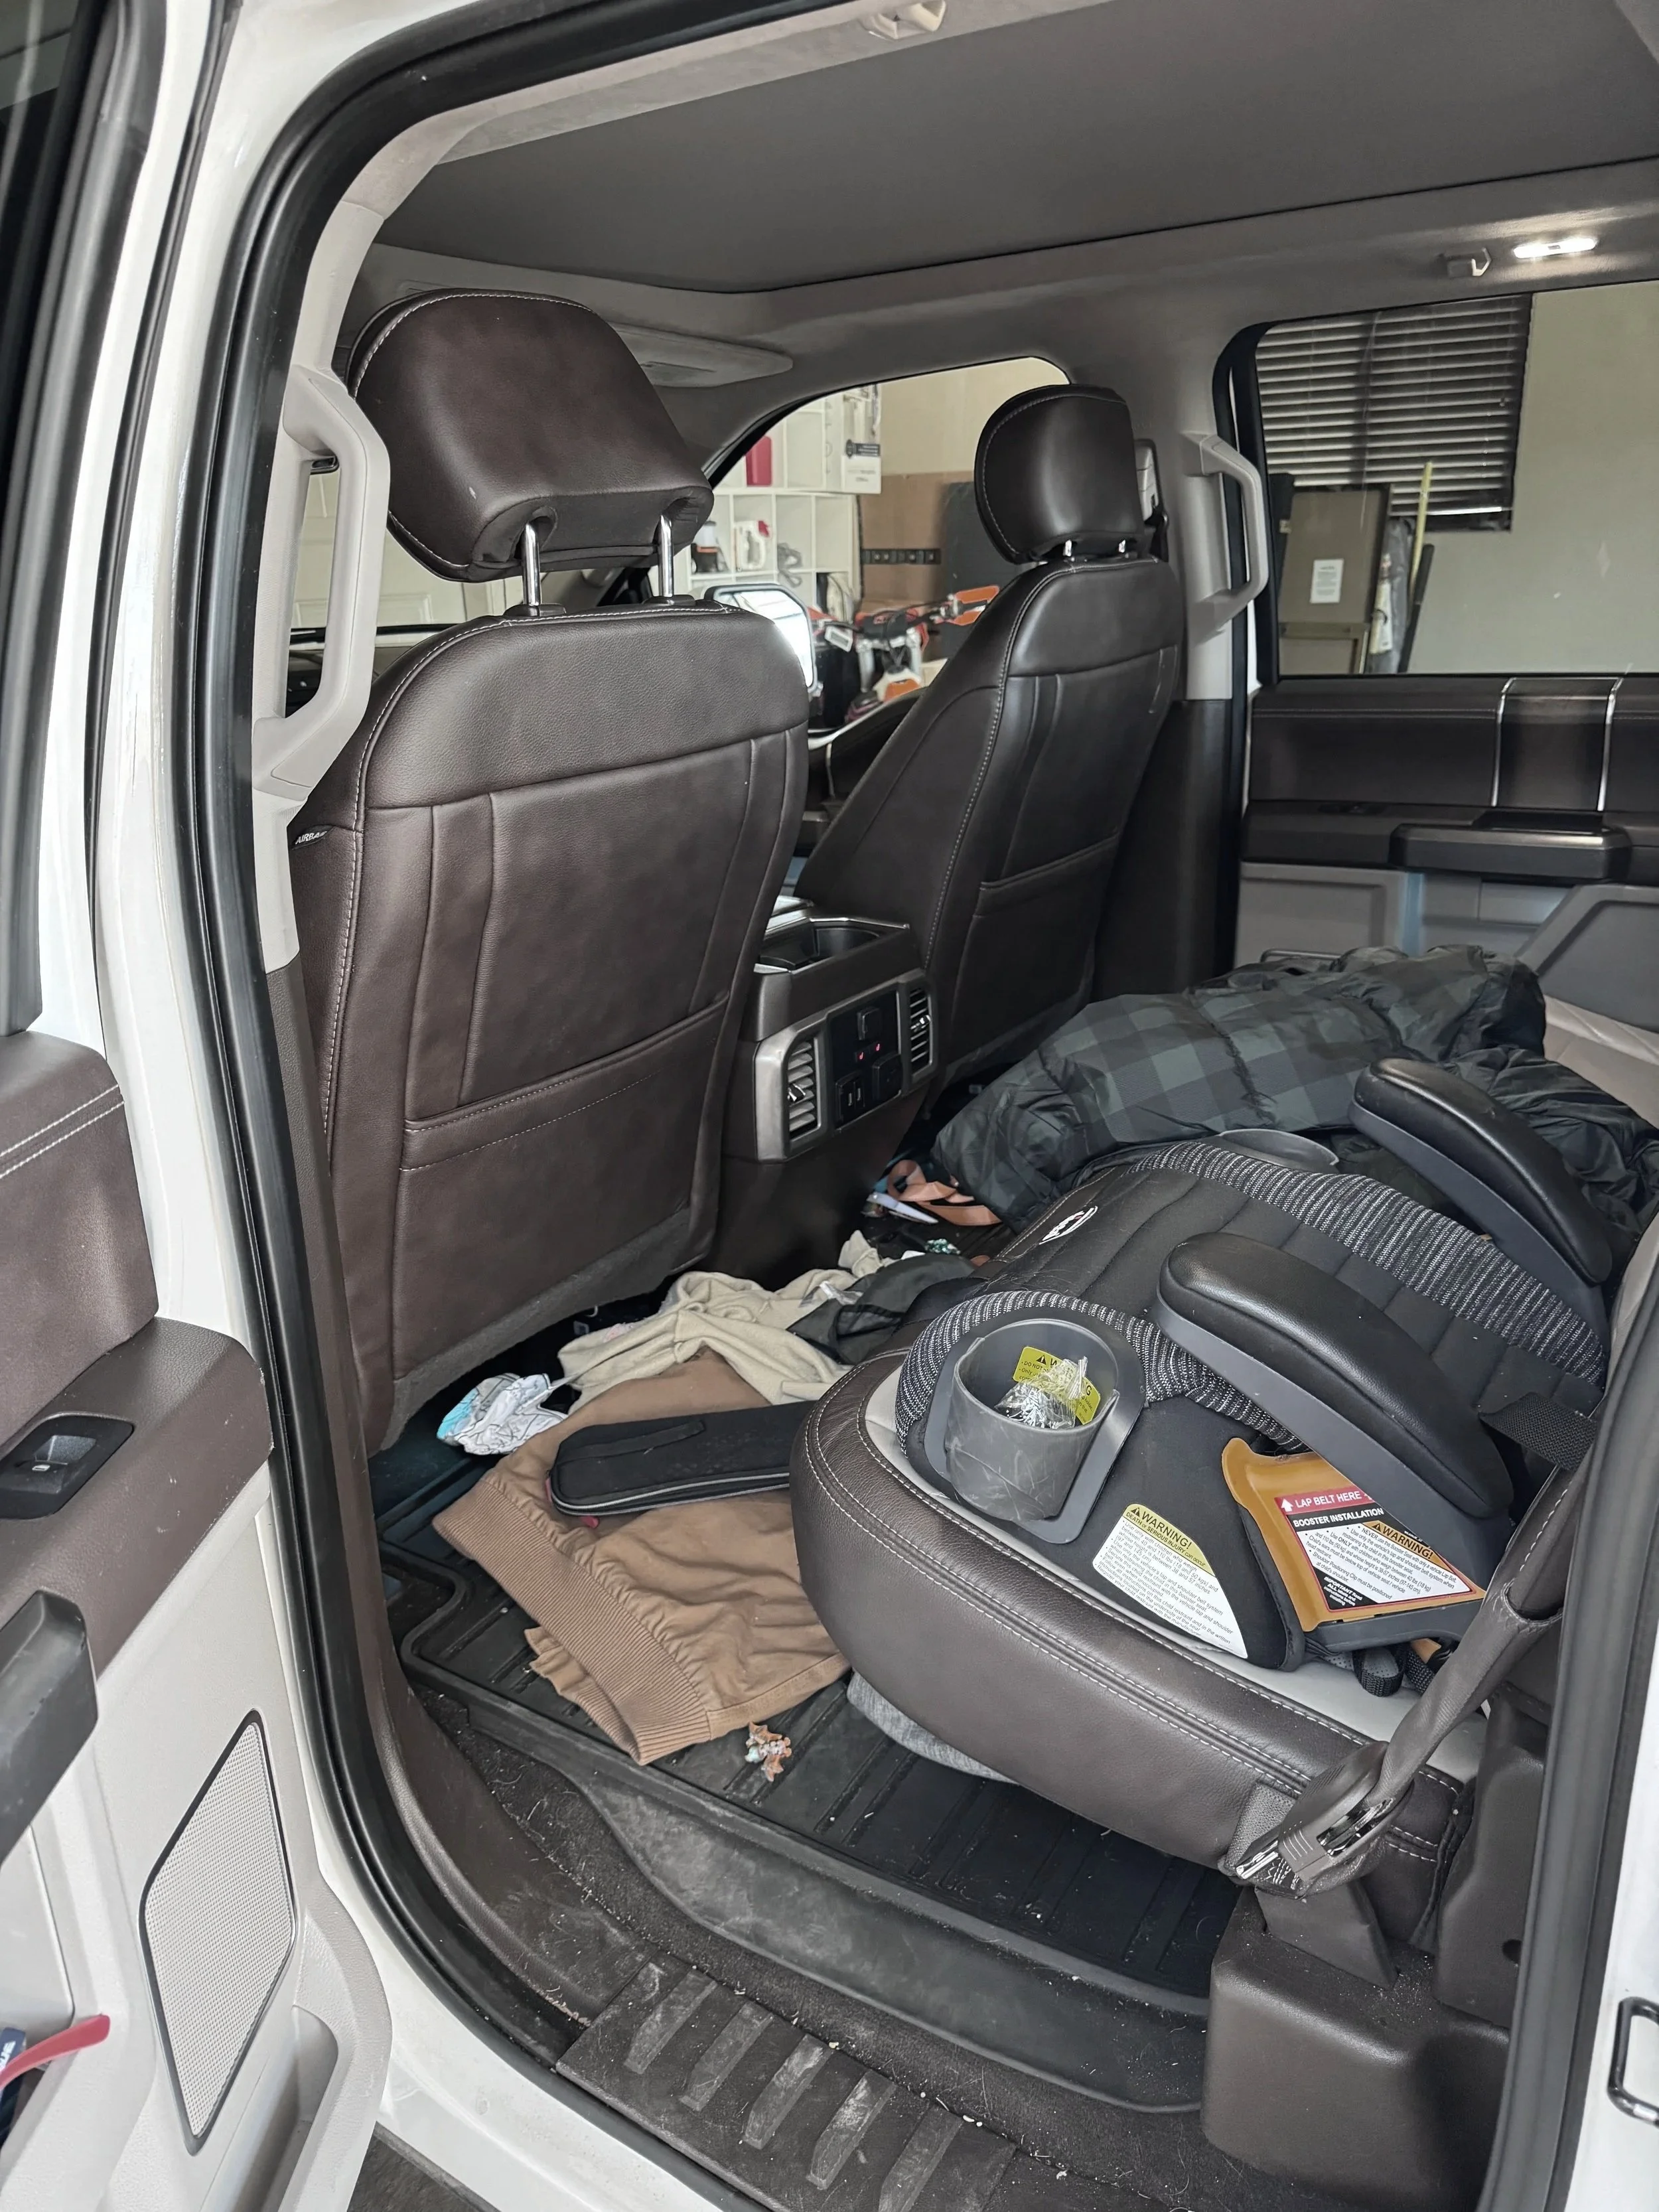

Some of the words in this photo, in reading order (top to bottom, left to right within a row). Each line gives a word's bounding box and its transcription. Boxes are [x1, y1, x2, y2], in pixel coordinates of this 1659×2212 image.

[1293, 1515, 1329, 1527] BOOSTER
[1330, 1507, 1384, 1522] INSTALLATION
[1295, 1498, 1313, 1508] LAP
[1313, 1494, 1334, 1505] BELT
[1336, 1490, 1362, 1502] HERE
[1123, 1540, 1133, 1549] and
[1133, 1547, 1143, 1556] 145
[1124, 1521, 1135, 1530] Use
[1133, 1528, 1144, 1538] only
[1144, 1535, 1155, 1544] with
[1154, 1541, 1173, 1556] children
[1172, 1554, 1183, 1563] who
[1125, 1512, 1142, 1525] DEATH
[1146, 1526, 1168, 1542] SERIOUS
[1167, 1540, 1185, 1554] INJURY
[1140, 1511, 1192, 1549] WARNING!
[1305, 1540, 1317, 1550] head
[1337, 1536, 1352, 1547] ONLY
[1361, 1527, 1378, 1540] NEVER
[1381, 1526, 1433, 1559] WARNING!
[1118, 1530, 1133, 1543] whose
[1151, 1554, 1172, 1570] between
[1178, 1571, 1189, 1580] and
[1194, 1581, 1211, 1594] inches
[1120, 1525, 1141, 1541] between
[1147, 1543, 1157, 1552] and
[1157, 1550, 1166, 1558] 110
[1181, 1566, 1191, 1575] and
[1196, 1576, 1209, 1587] kgs)
[1208, 1583, 1218, 1592] and
[1308, 1534, 1323, 1546] Child's
[1329, 1548, 1340, 1556] must
[1344, 1556, 1356, 1566] below
[1366, 1568, 1382, 1580] vehicle
[1391, 1582, 1406, 1593] vehicle
[1312, 1551, 1331, 1564] Shoulder
[1328, 1560, 1350, 1576] Positioning
[1348, 1572, 1358, 1581] Clip
[1356, 1577, 1367, 1585] must
[1371, 1585, 1392, 1600] positioned
[1358, 1533, 1368, 1542] only
[1404, 1558, 1421, 1572] shoulder
[1427, 1572, 1443, 1584] system
[1442, 1579, 1455, 1589] when
[1368, 1546, 1378, 1555] child
[1388, 1558, 1404, 1569] booster
[1112, 1539, 1123, 1548] Use
[1159, 1572, 1168, 1580] lap
[1167, 1577, 1177, 1586] and
[1176, 1582, 1197, 1599] shoulder
[1196, 1595, 1206, 1605] belt
[1205, 1602, 1223, 1617] system
[1152, 1574, 1165, 1584] child
[1169, 1585, 1179, 1593] this
[1177, 1590, 1196, 1605] booster
[1327, 1582, 1338, 1591] ALL
[1122, 1560, 1132, 1568] this
[1131, 1566, 1143, 1576] child
[1142, 1574, 1161, 1589] restraint
[1161, 1586, 1171, 1595] with
[1179, 1597, 1196, 1611] vehicle
[1202, 1613, 1214, 1622] and
[1212, 1618, 1234, 1635] shoulder
[1153, 1594, 1163, 1603] this
[1161, 1599, 1174, 1609] child
[1173, 1606, 1192, 1622] restraint
[1191, 1618, 1202, 1627] and
[1214, 1632, 1231, 1645] written
